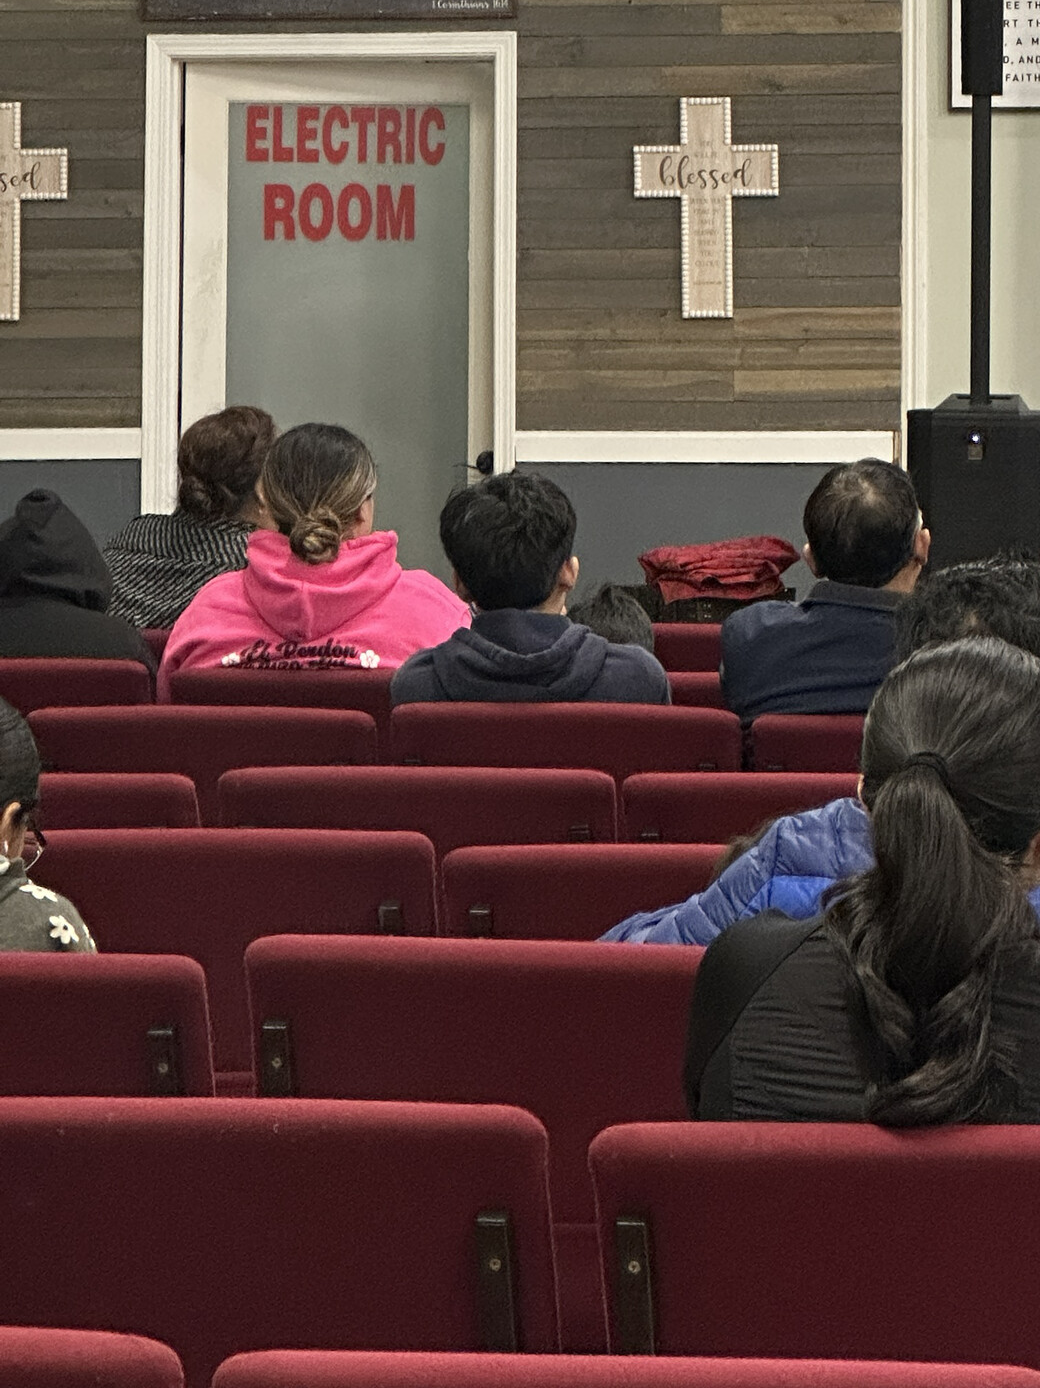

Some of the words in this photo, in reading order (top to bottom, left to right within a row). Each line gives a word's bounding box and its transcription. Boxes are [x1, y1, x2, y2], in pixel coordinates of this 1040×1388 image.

[1016, 37, 1023, 45] A
[1005, 74, 1040, 82] FAITH
[245, 105, 446, 165] ELECTRIC
[659, 155, 753, 190] blessed
[263, 182, 415, 242] ROOM
